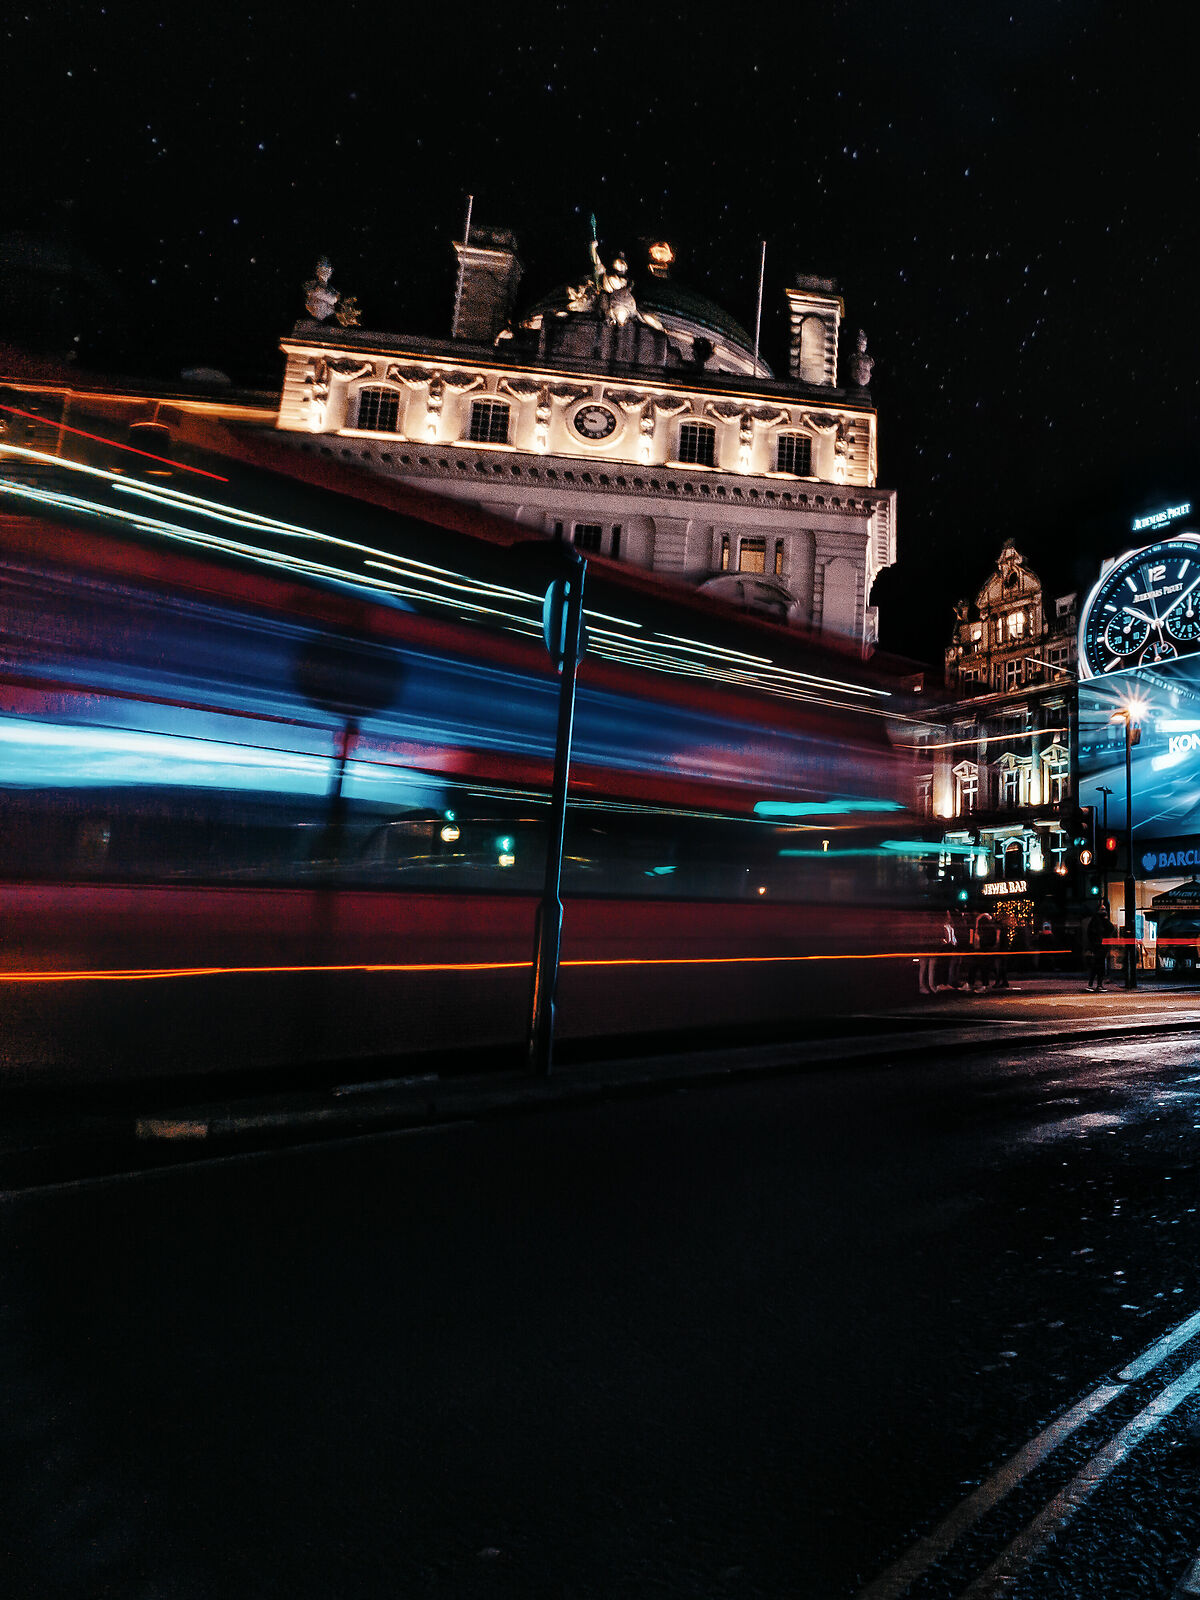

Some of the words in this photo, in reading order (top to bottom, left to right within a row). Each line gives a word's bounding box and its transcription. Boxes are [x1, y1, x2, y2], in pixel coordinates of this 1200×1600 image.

[1148, 564, 1166, 583] 12
[982, 882, 1008, 896] JEWEL
[1009, 880, 1027, 893] BAR
